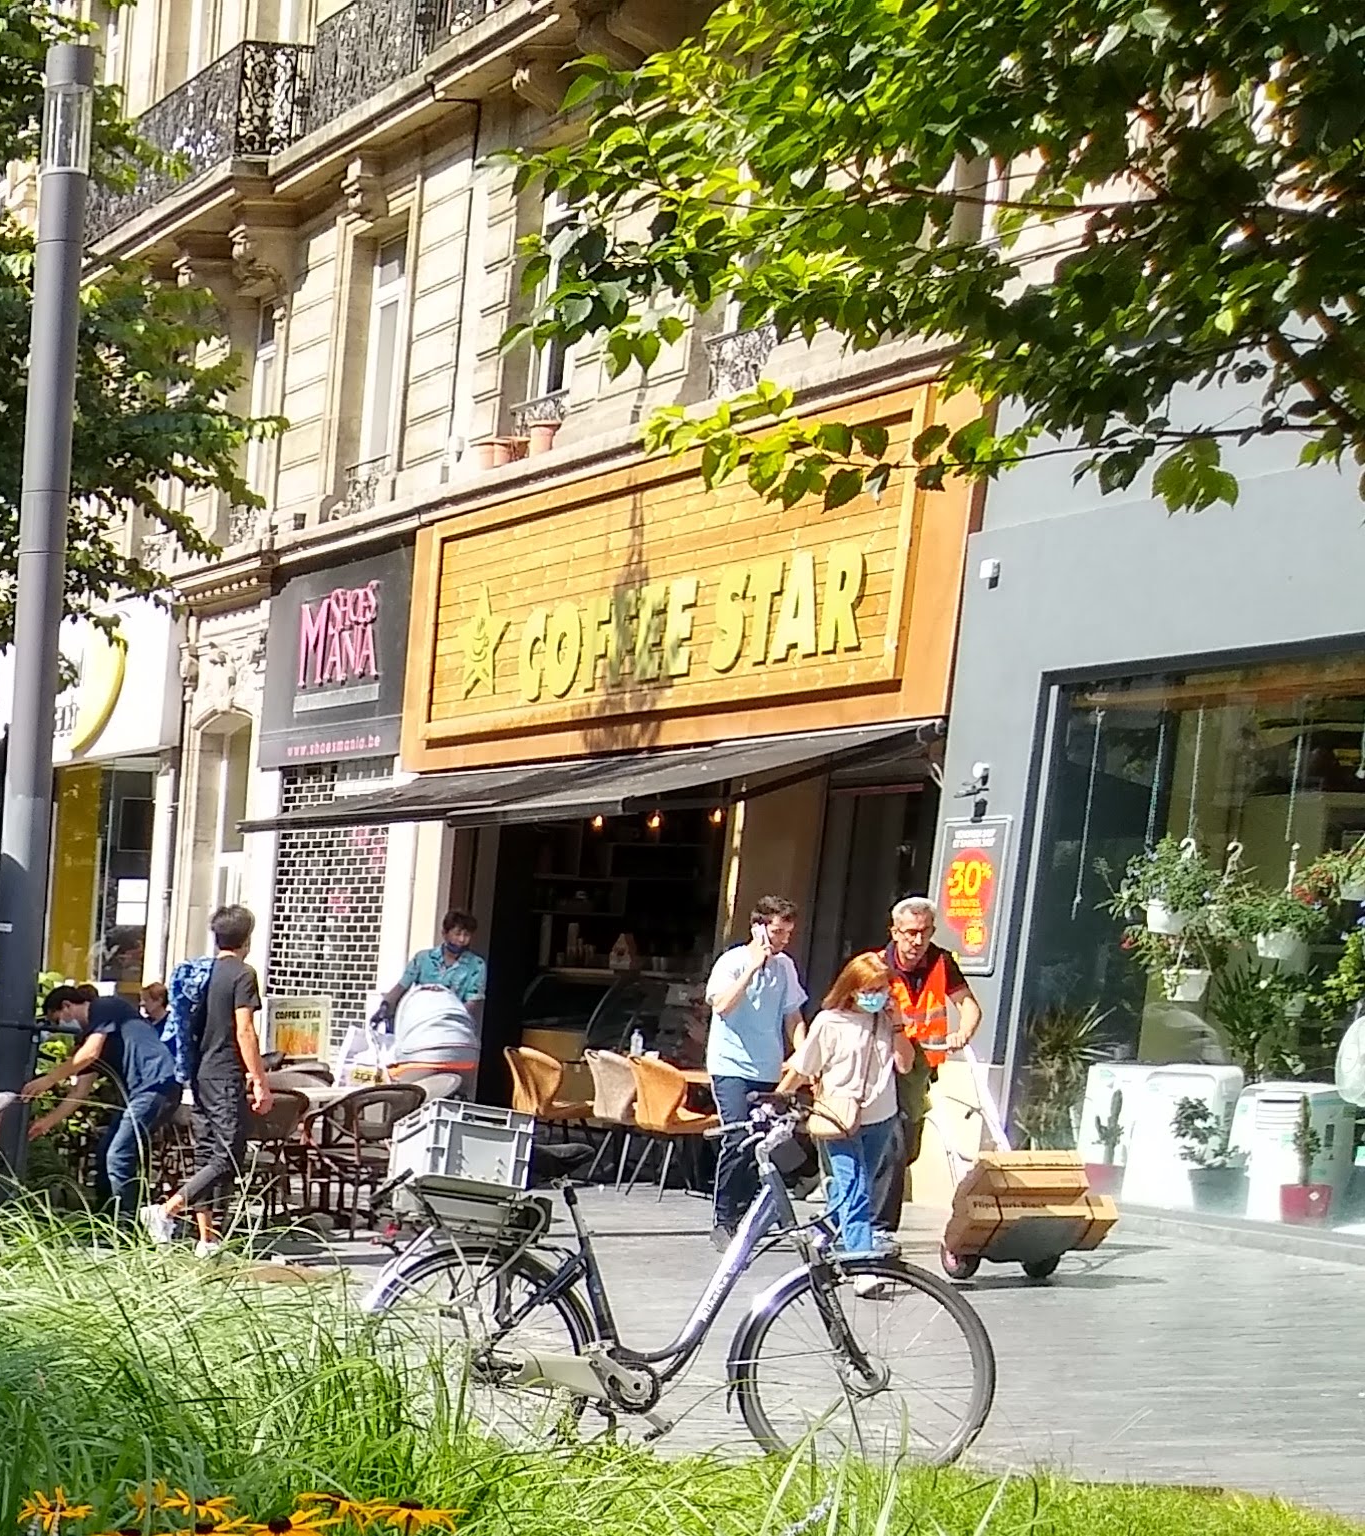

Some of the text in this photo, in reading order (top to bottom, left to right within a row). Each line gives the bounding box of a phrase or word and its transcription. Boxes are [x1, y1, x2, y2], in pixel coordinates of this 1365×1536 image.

[517, 541, 867, 702] COFFEE STAR
[275, 1010, 321, 1020] COFFEE STAR
